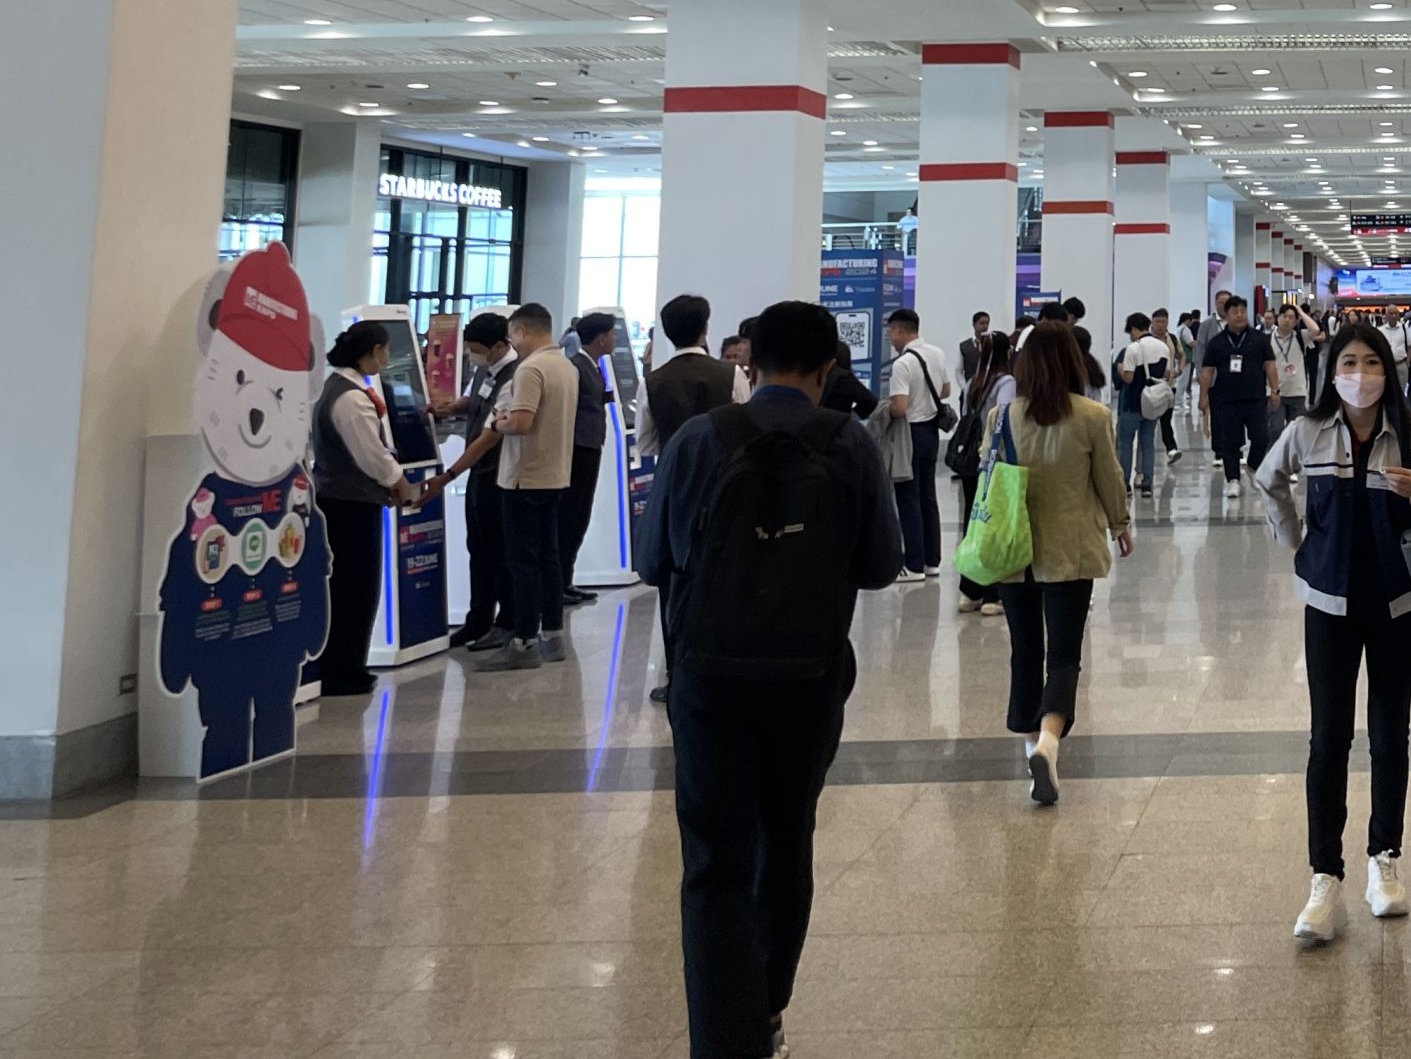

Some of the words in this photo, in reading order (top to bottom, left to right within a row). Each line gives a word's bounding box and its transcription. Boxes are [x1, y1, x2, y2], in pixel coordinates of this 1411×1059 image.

[380, 173, 457, 202] STARBUCKS
[459, 184, 502, 208] COFFEE
[233, 504, 263, 517] FOLLOW
